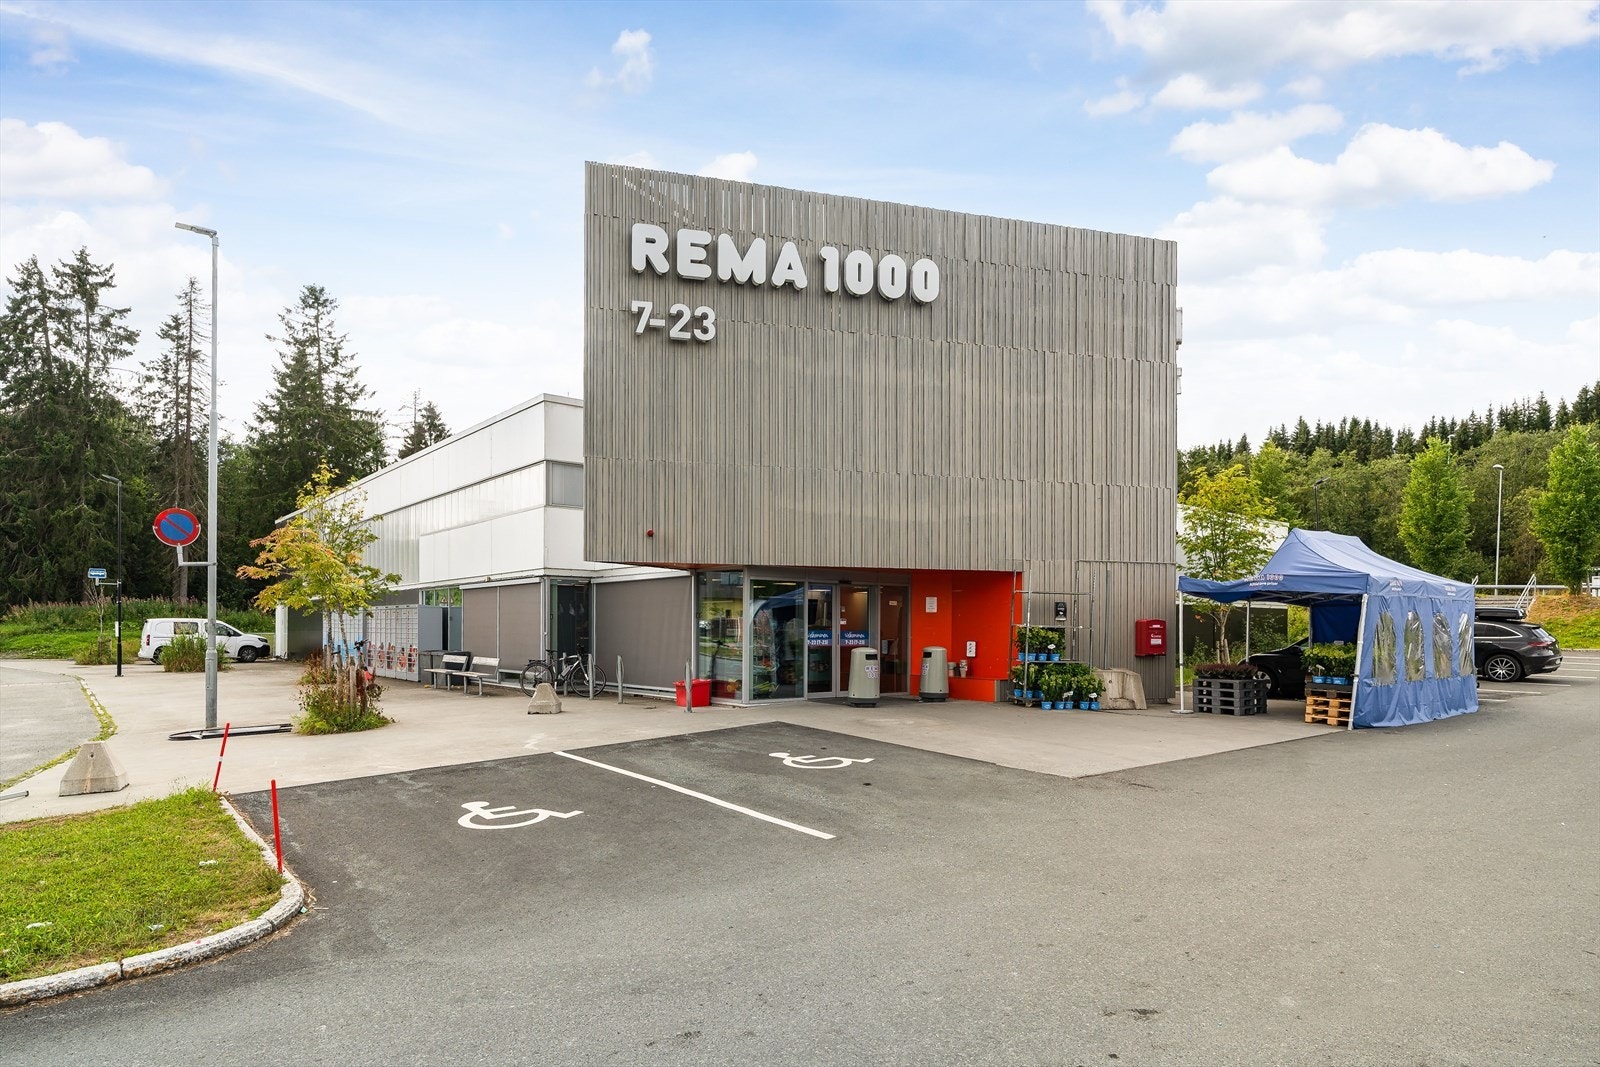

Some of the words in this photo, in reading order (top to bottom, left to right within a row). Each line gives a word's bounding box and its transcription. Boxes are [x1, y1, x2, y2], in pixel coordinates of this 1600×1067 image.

[631, 223, 808, 290] REMA
[819, 246, 940, 305] 1000
[631, 300, 716, 343] 7-23
